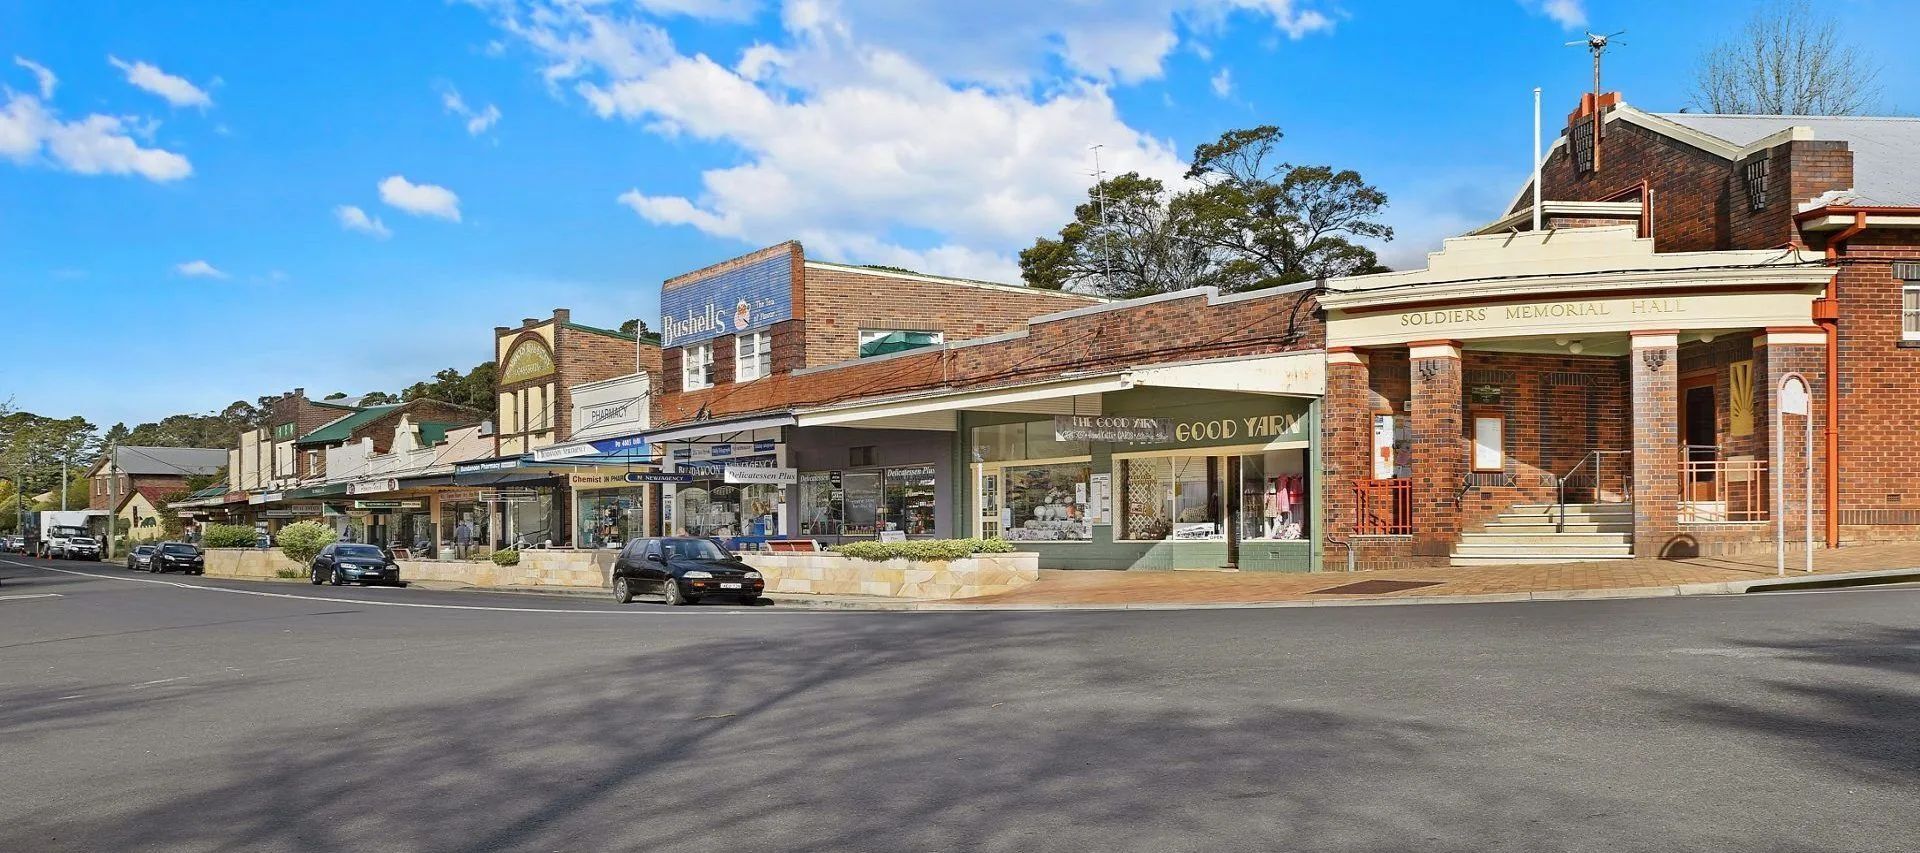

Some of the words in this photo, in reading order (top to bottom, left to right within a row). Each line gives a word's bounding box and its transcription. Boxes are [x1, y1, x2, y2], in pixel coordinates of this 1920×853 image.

[1506, 301, 1611, 320] MEMORIAL
[1632, 299, 1687, 315] HALL
[592, 406, 627, 422] PHARMACY
[1072, 415, 1093, 428] THE
[1096, 417, 1130, 428] GOOD
[1133, 418, 1158, 429] YARN
[1176, 419, 1237, 442] GOOD
[1243, 414, 1300, 438] YARN
[572, 475, 602, 484] Chemist
[728, 470, 777, 480] Delicatessen
[778, 472, 796, 480] Plus
[887, 469, 921, 477] Delicatessen
